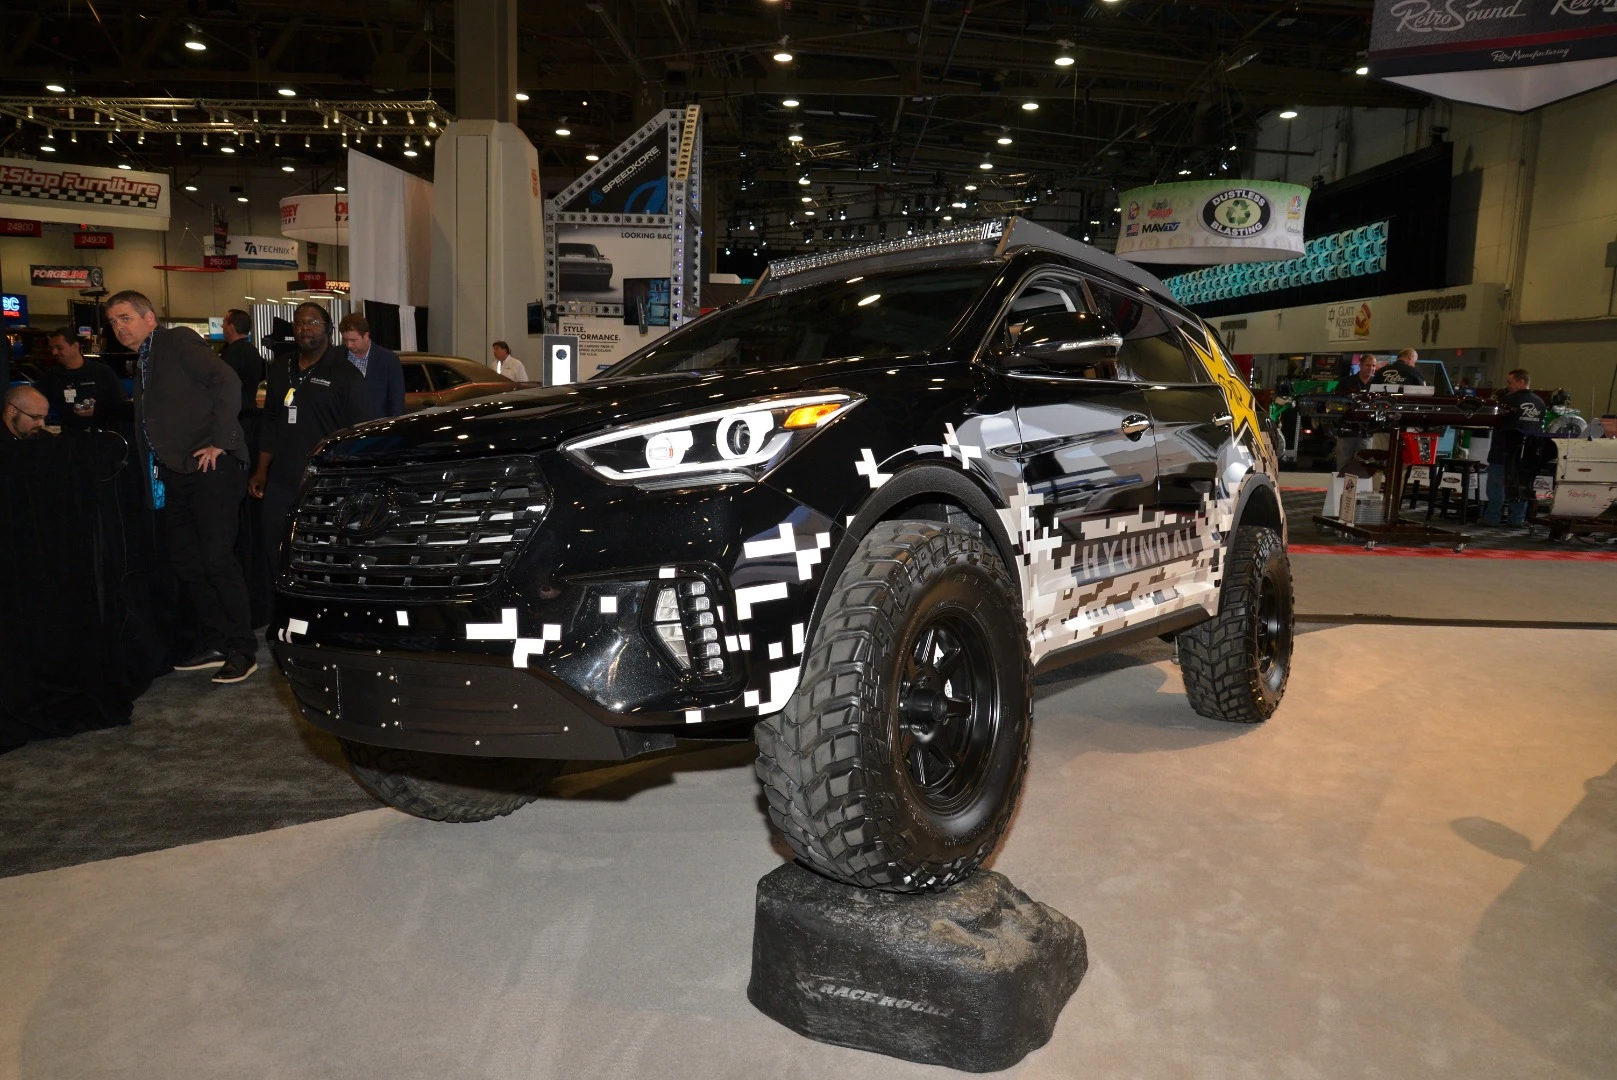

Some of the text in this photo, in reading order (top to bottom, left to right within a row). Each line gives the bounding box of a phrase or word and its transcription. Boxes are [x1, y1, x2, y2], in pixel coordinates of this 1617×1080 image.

[602, 145, 660, 193] SPEEDKORE
[61, 171, 160, 197] Furniture
[1212, 190, 1266, 207] DUSTLESS
[1210, 220, 1263, 236] BLASTING
[81, 235, 107, 244] 24900
[621, 232, 656, 240] LOOKING
[244, 242, 290, 255] TA TECHNIX
[33, 269, 89, 279] FORGELINE
[1338, 306, 1355, 316] GLATT
[1336, 317, 1354, 327] KOSHER
[1338, 328, 1350, 338] DELI
[1382, 369, 1405, 384] Retro
[1082, 528, 1194, 580] HYUNDAI
[819, 982, 879, 1003] RACE
